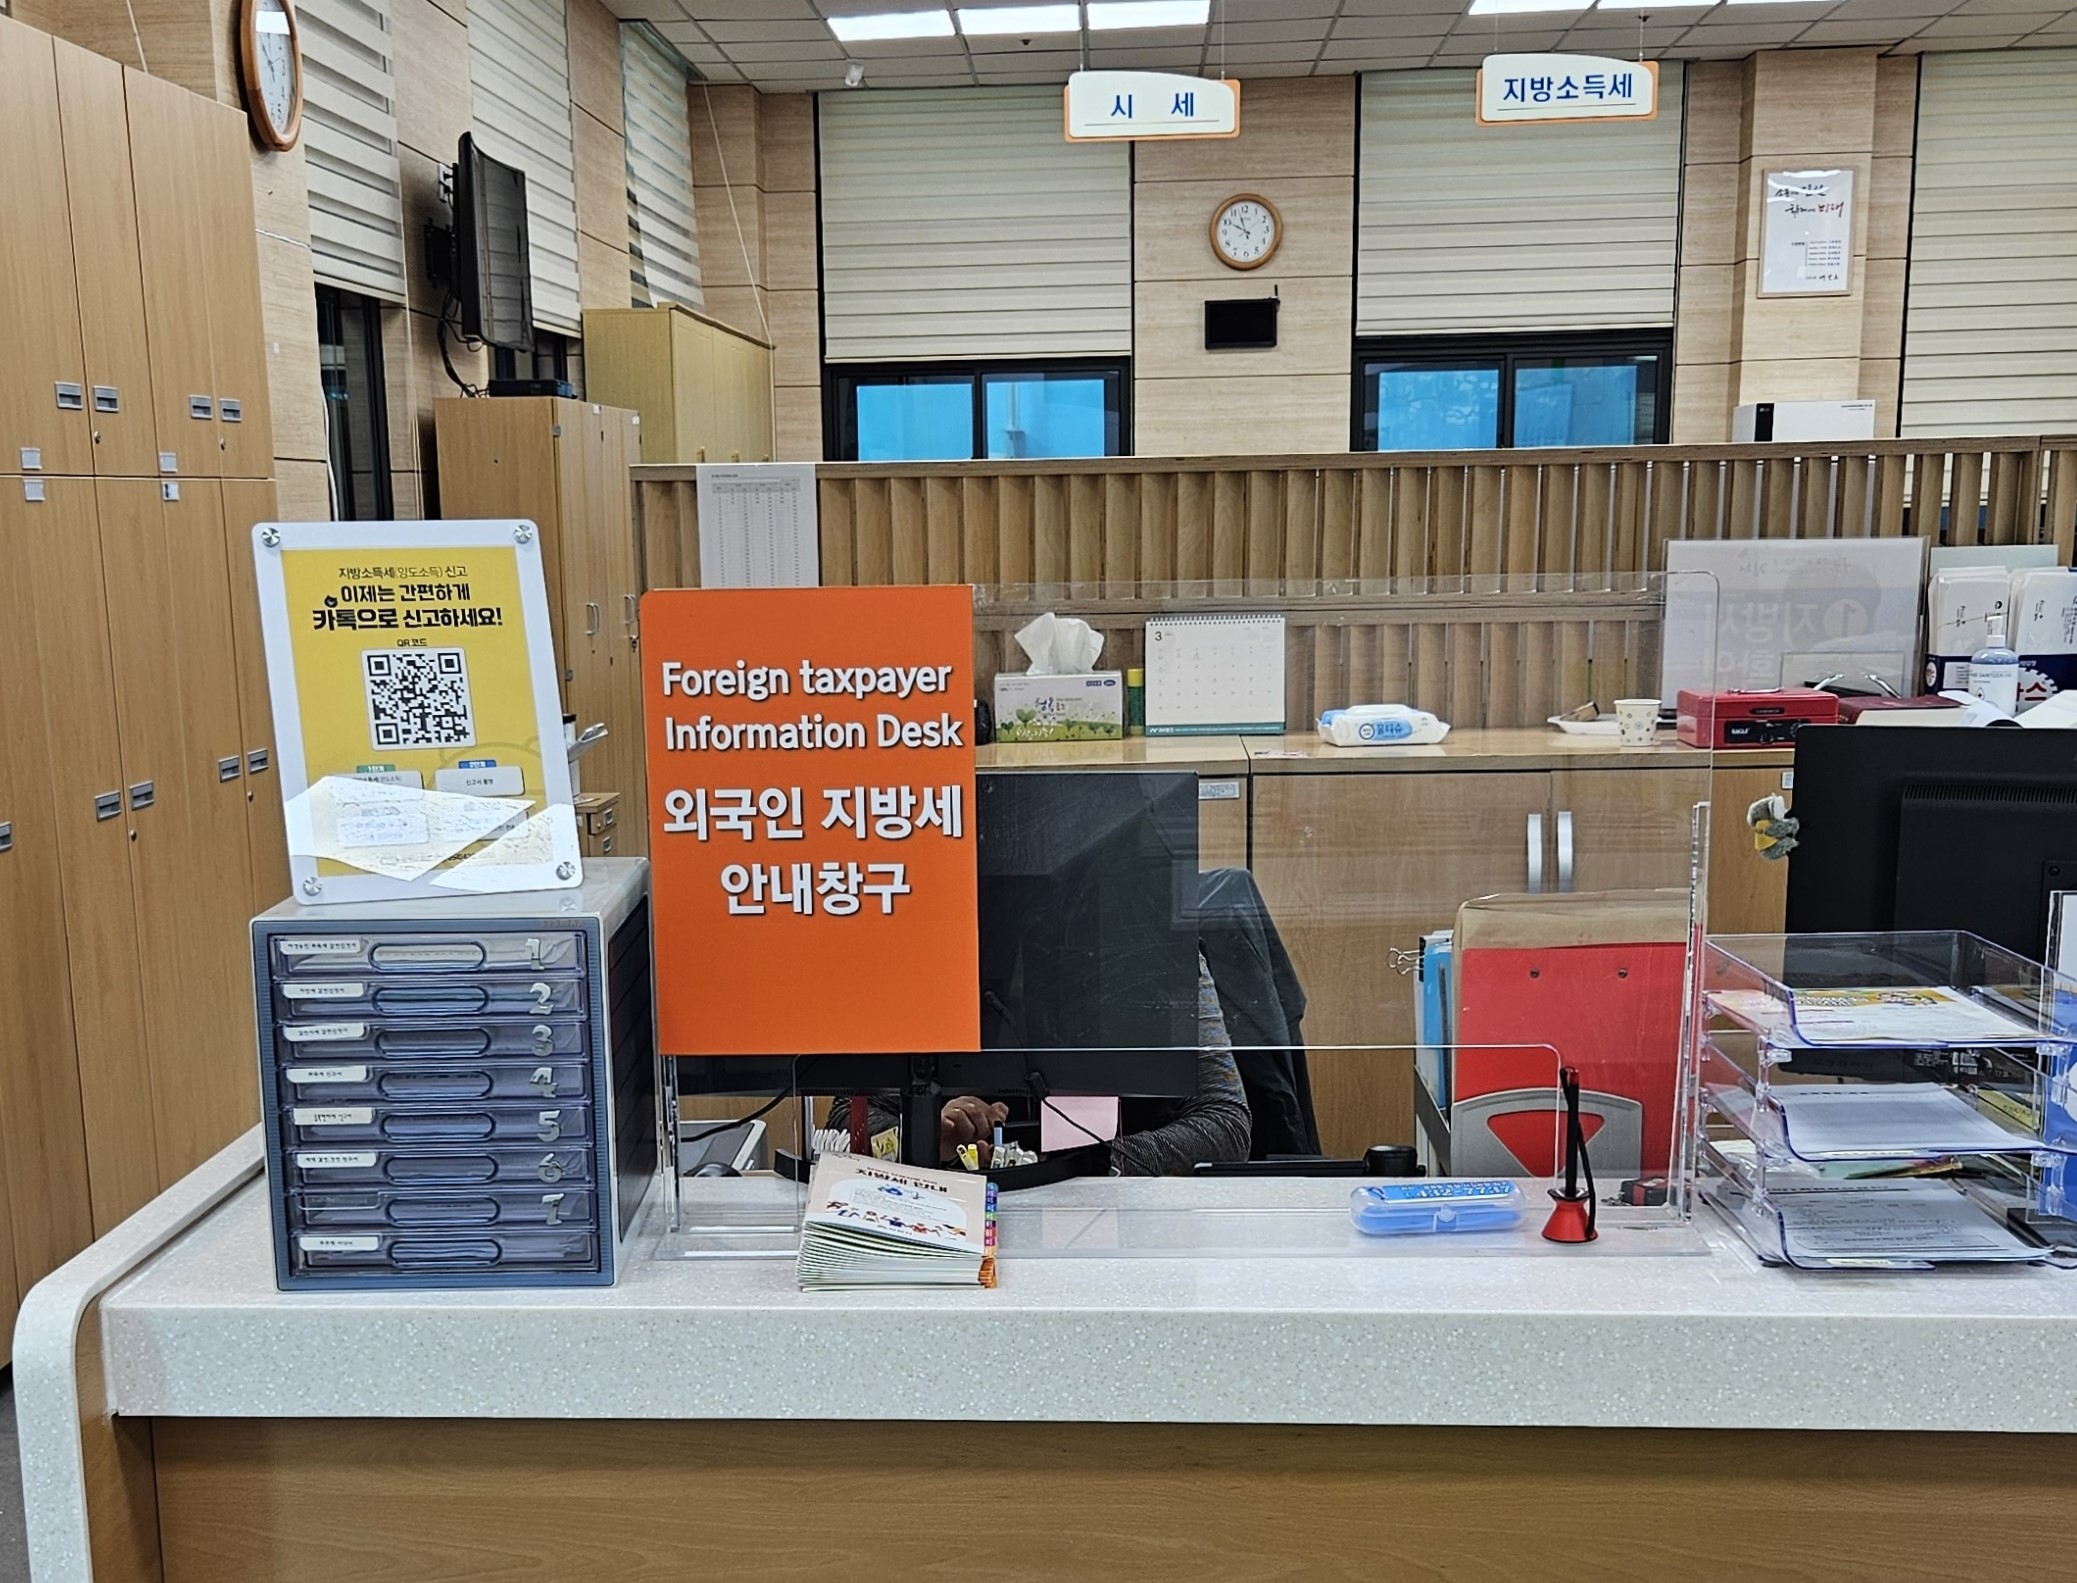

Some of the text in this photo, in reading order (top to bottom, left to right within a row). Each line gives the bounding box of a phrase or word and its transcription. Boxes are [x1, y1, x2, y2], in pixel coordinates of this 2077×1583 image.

[1503, 73, 1633, 103] 지방소득세
[445, 566, 468, 578] 신고
[341, 583, 471, 603] 이제는 간편하게
[313, 607, 503, 631] 카톡으로 신고하세요!
[1155, 631, 1162, 641] 3
[662, 658, 953, 701] Foreign taxpayer
[665, 712, 964, 751] Information Desk
[663, 784, 963, 841] 외국인 지방세
[720, 861, 910, 916] 안내창구
[525, 938, 545, 970] 1
[529, 982, 554, 1015] 2
[531, 1024, 555, 1057] 3
[529, 1067, 559, 1098] 4
[537, 1110, 561, 1142] 5
[538, 1152, 562, 1183] 6
[542, 1193, 565, 1225] 7
